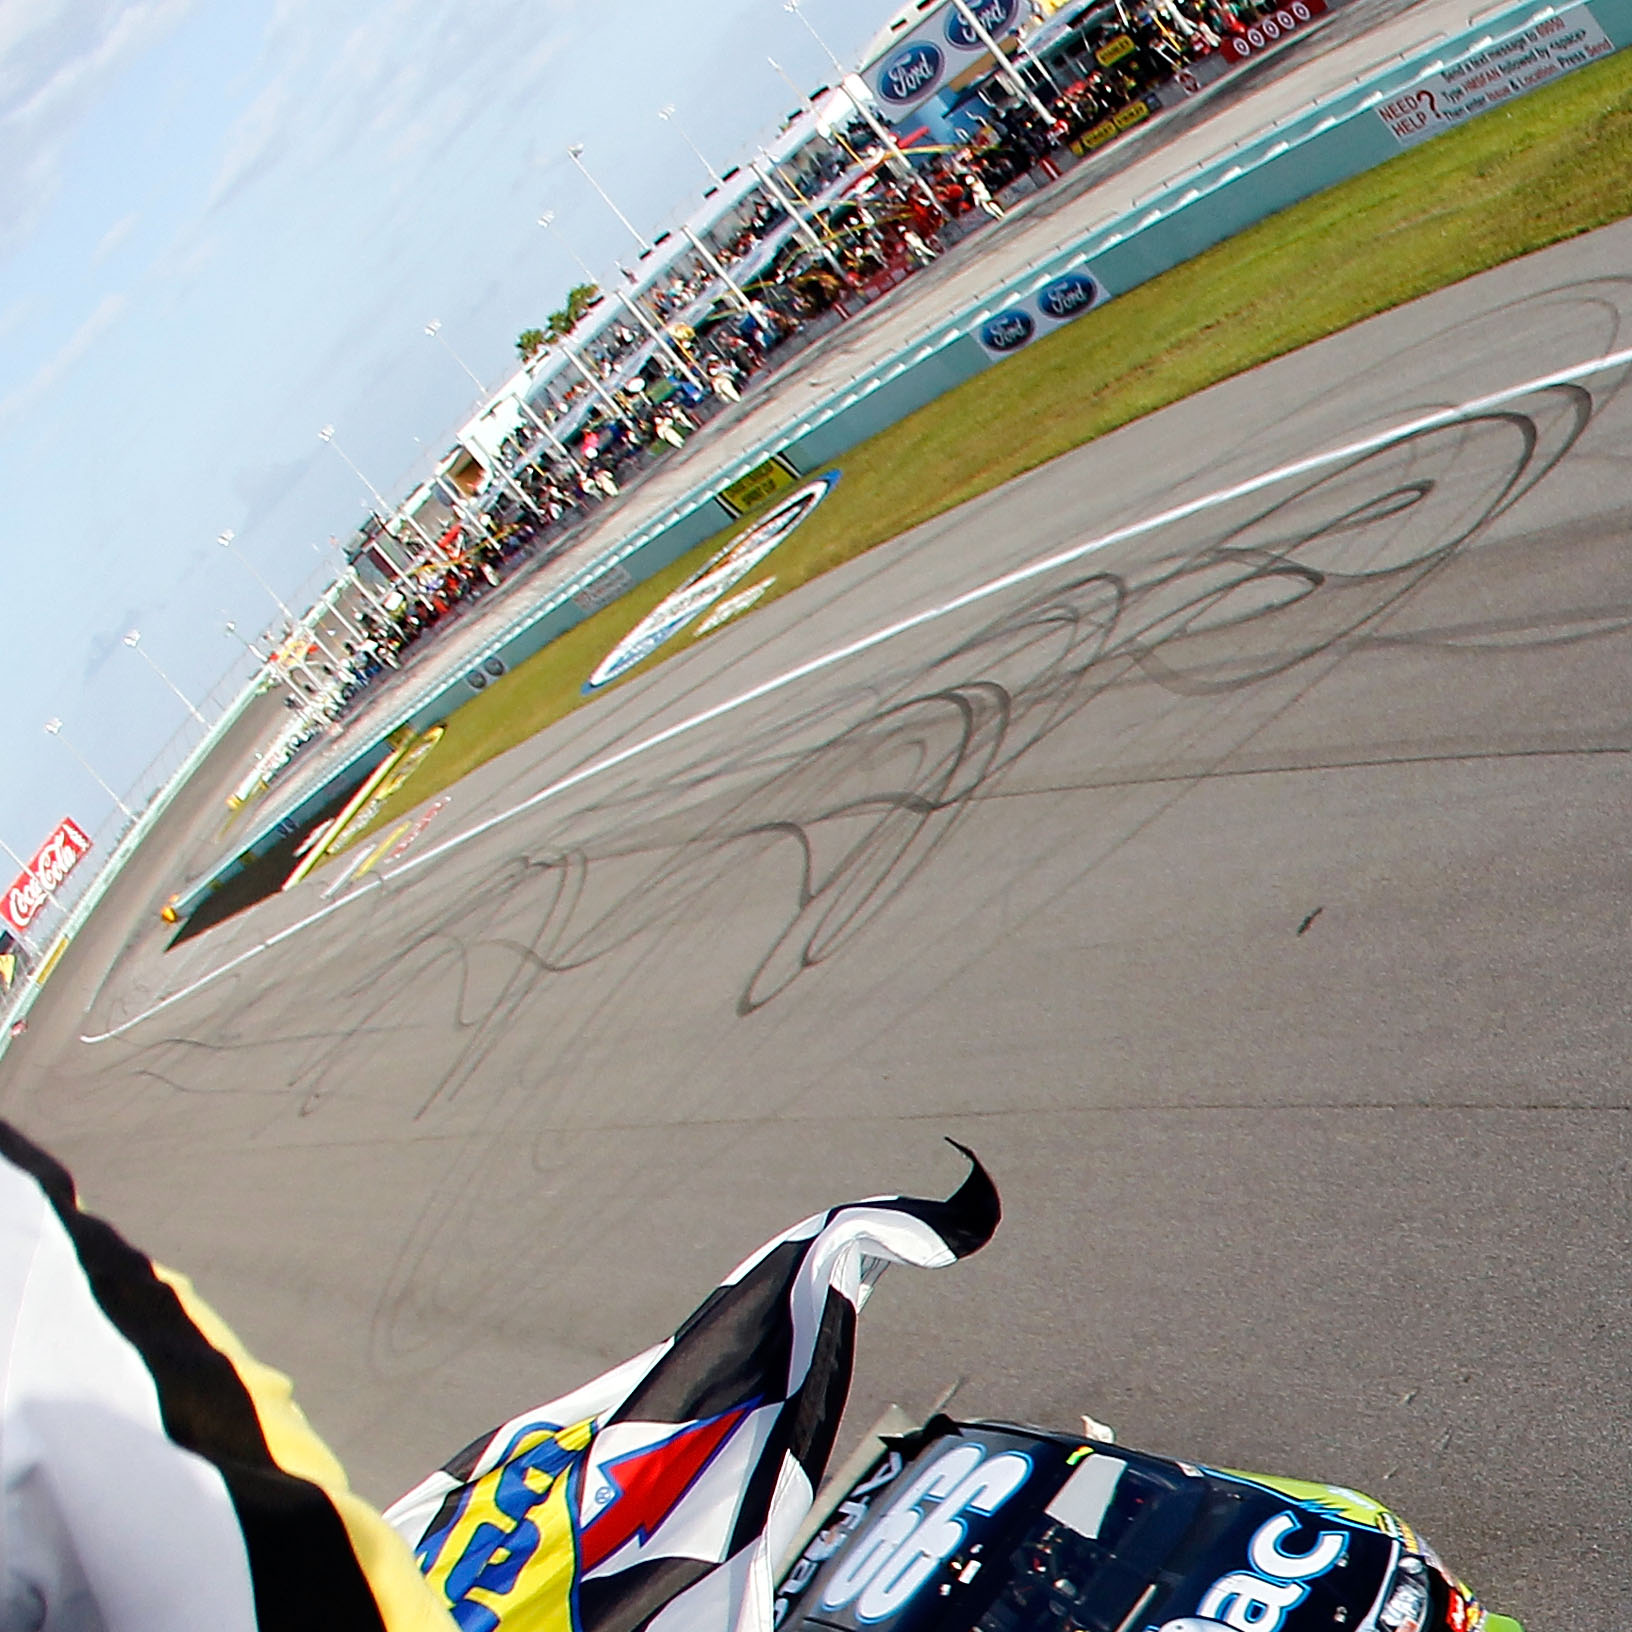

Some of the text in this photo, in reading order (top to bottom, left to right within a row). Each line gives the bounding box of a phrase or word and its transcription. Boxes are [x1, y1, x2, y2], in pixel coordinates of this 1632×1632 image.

[888, 51, 934, 98] Ford
[1379, 97, 1418, 122] NEED
[1391, 111, 1427, 136] HELP
[1047, 281, 1088, 313] Ford
[990, 318, 1025, 346] Ford
[822, 1443, 1034, 1624] 99
